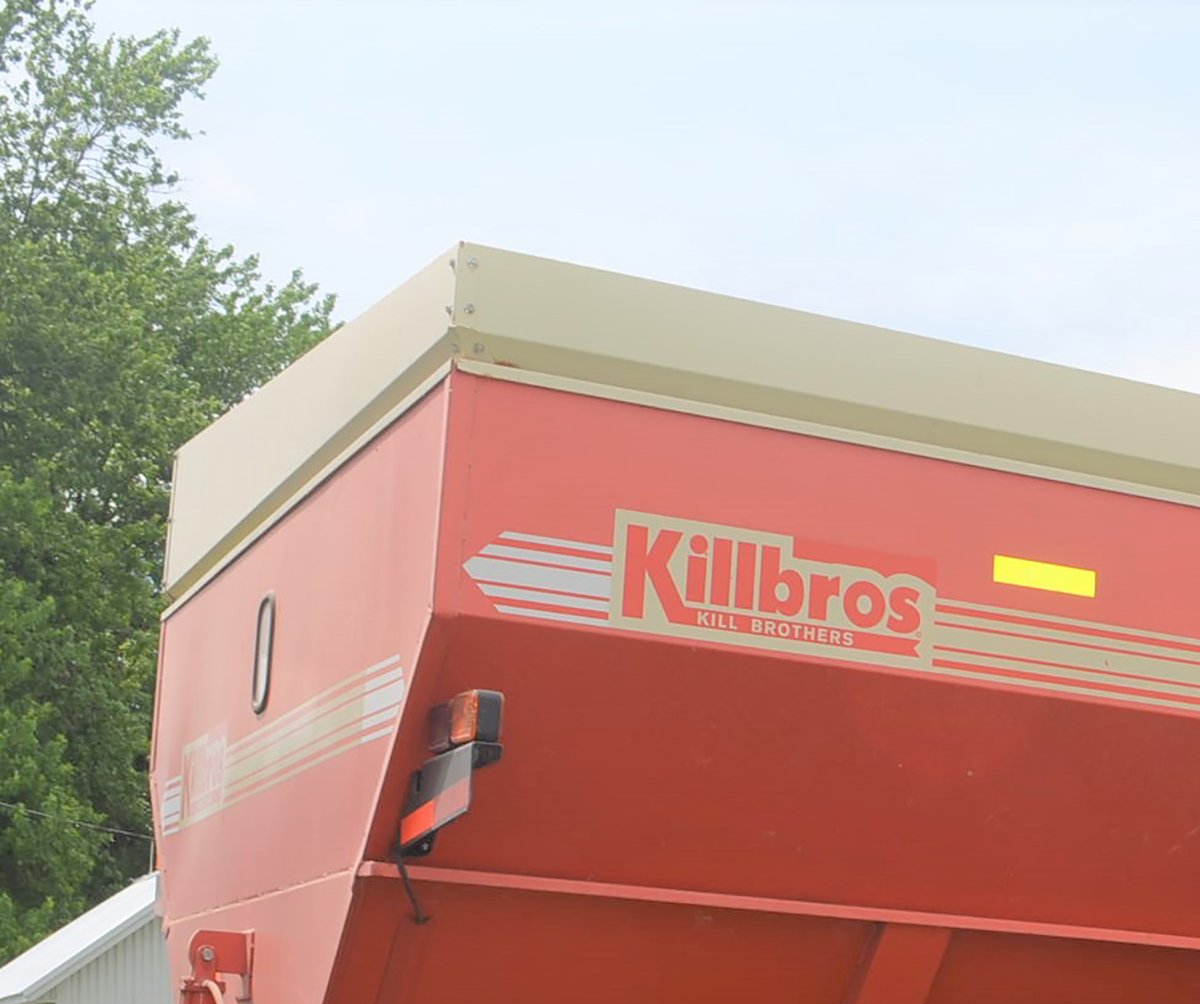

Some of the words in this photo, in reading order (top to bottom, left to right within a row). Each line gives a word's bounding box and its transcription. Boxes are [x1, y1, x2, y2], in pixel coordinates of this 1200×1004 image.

[622, 523, 921, 634] Killbros
[697, 611, 738, 630] KILL
[751, 620, 854, 646] BROTHERS
